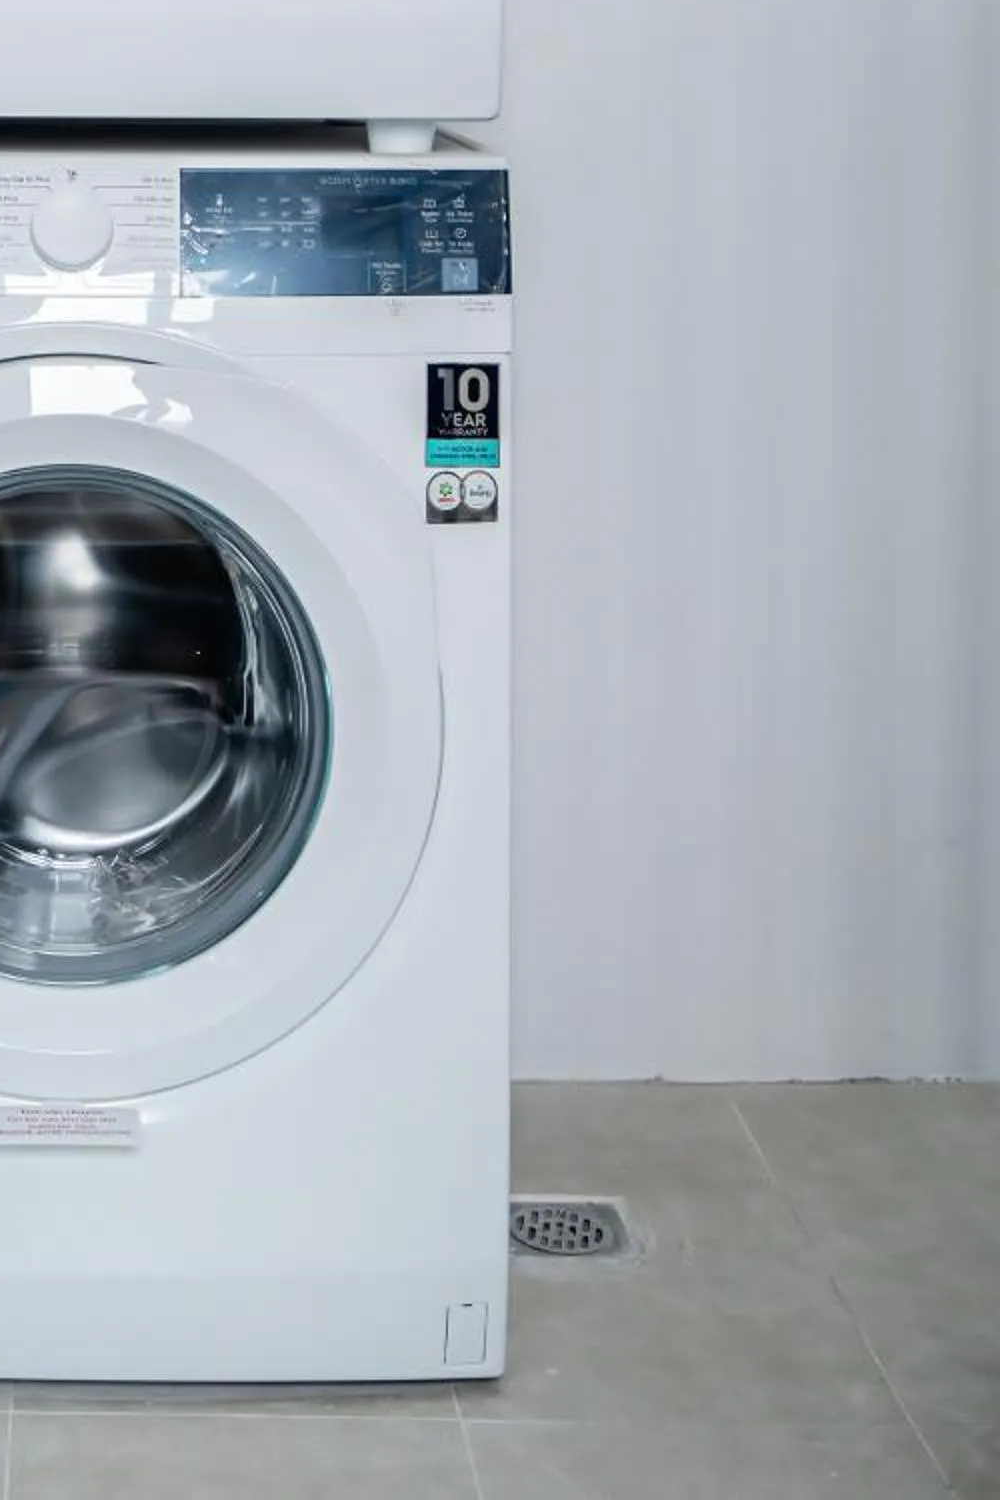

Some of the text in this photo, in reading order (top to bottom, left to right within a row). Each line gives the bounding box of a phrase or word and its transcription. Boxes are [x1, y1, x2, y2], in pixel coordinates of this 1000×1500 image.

[437, 367, 490, 412] 10
[441, 412, 487, 427] YEAR
[438, 427, 489, 437] WARRANTY
